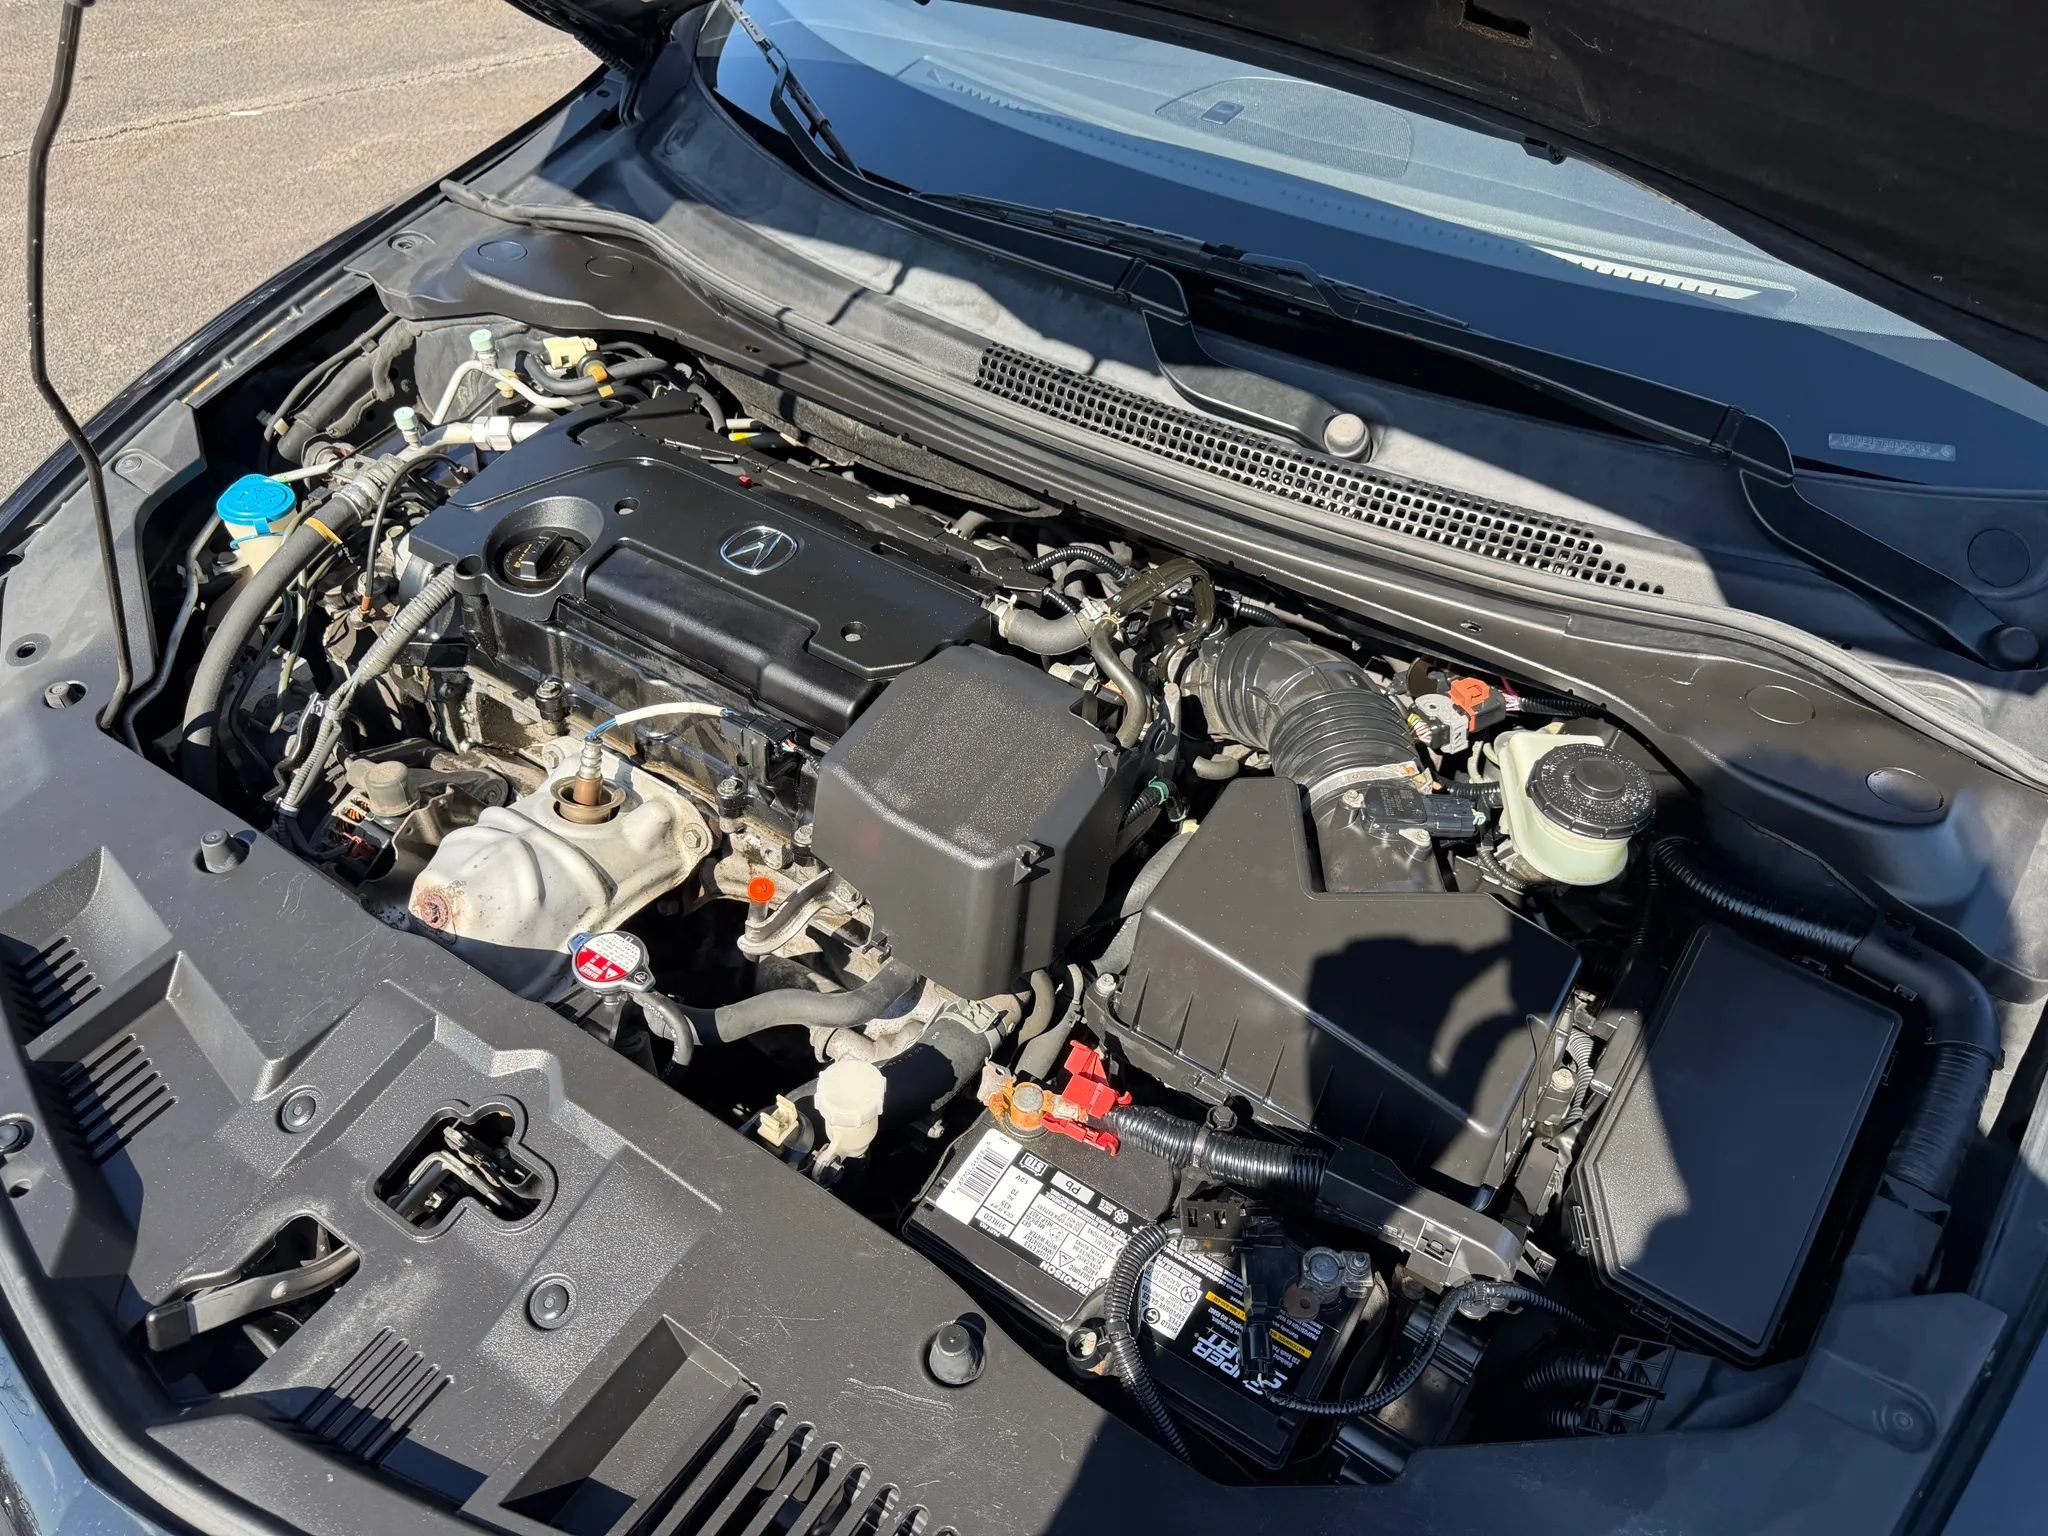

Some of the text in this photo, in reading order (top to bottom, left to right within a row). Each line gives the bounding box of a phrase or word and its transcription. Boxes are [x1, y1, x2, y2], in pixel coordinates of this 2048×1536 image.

[1023, 1154, 1044, 1173] STD
[1015, 1173, 1028, 1184] 12V
[1063, 1179, 1081, 1195] Pb
[1021, 1219, 1031, 1228] GET
[1157, 1301, 1185, 1321] EXPLOSIVE
[1159, 1319, 1178, 1333] SHIELD
